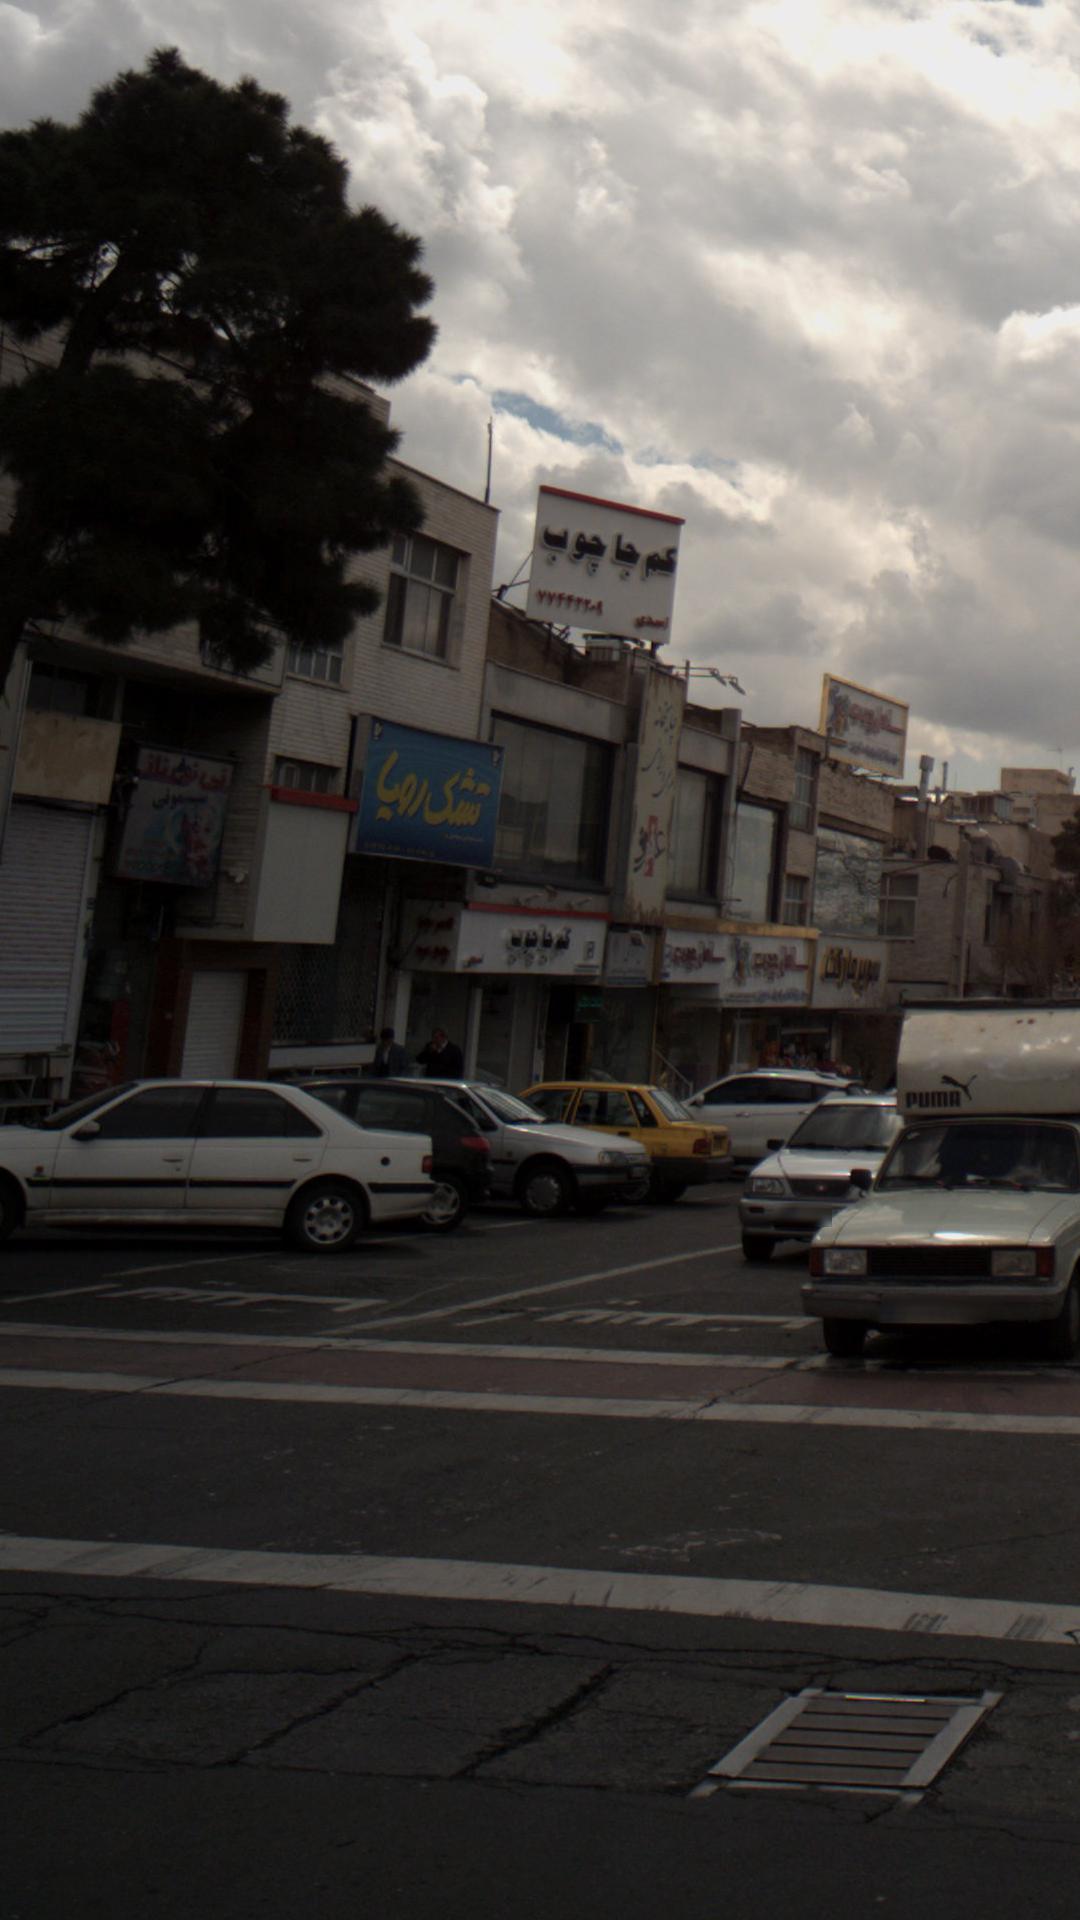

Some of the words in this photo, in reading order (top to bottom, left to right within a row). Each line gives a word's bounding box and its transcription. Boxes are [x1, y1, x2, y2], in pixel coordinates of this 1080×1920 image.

[542, 526, 607, 576] چوب
[644, 547, 678, 578] کم
[375, 750, 430, 823] رویا
[423, 767, 491, 827] تشک
[905, 1090, 961, 1108] PUMA
